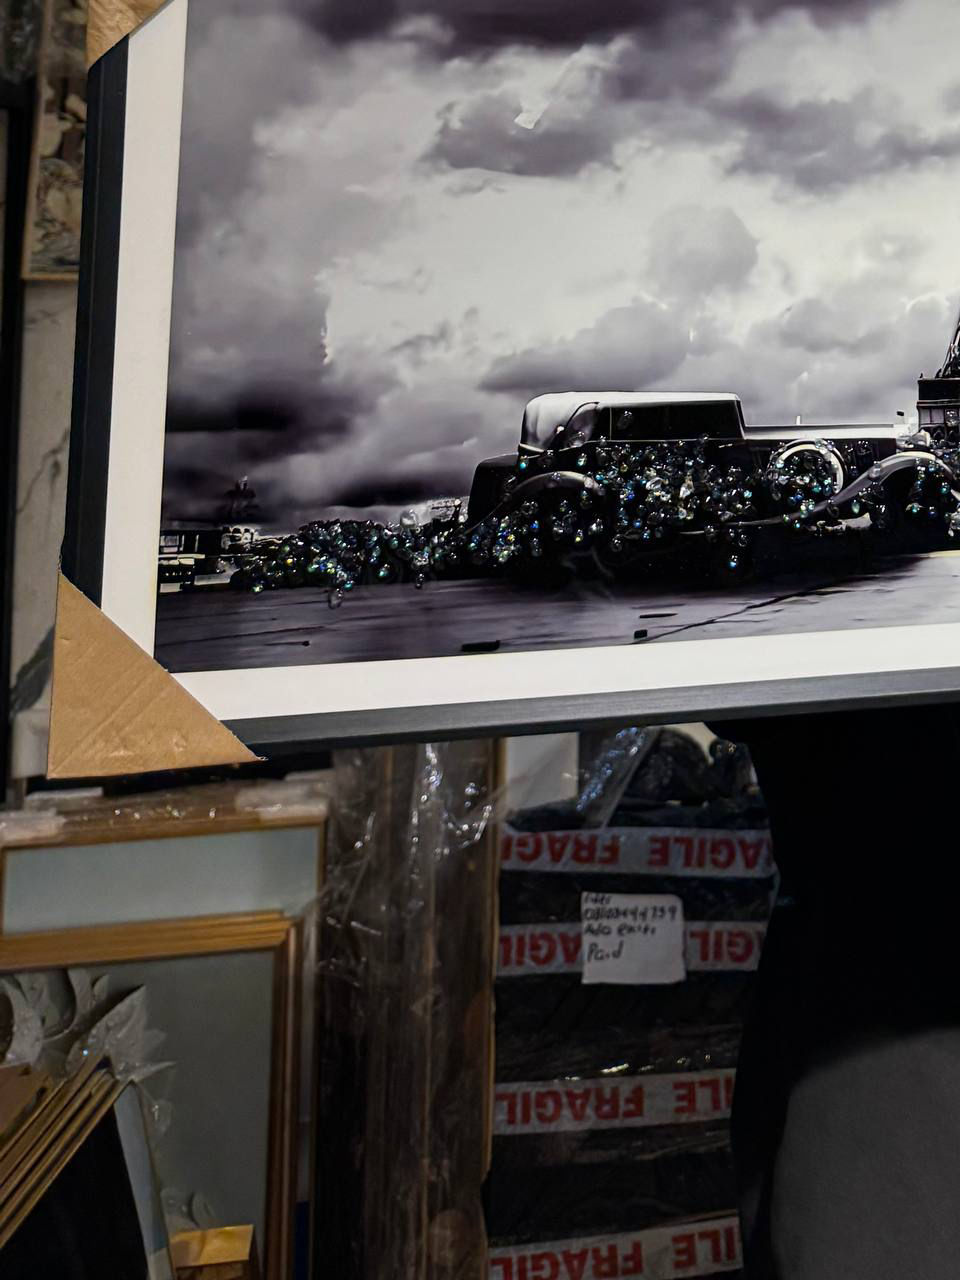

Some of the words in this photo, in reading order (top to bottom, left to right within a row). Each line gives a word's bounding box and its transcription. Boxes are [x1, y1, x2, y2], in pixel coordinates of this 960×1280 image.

[648, 834, 774, 870] AGILE
[587, 939, 624, 962] Paid
[684, 929, 763, 965] GIL
[496, 1084, 644, 1126] FRAGIL
[491, 1240, 643, 1280] FRAGIL
